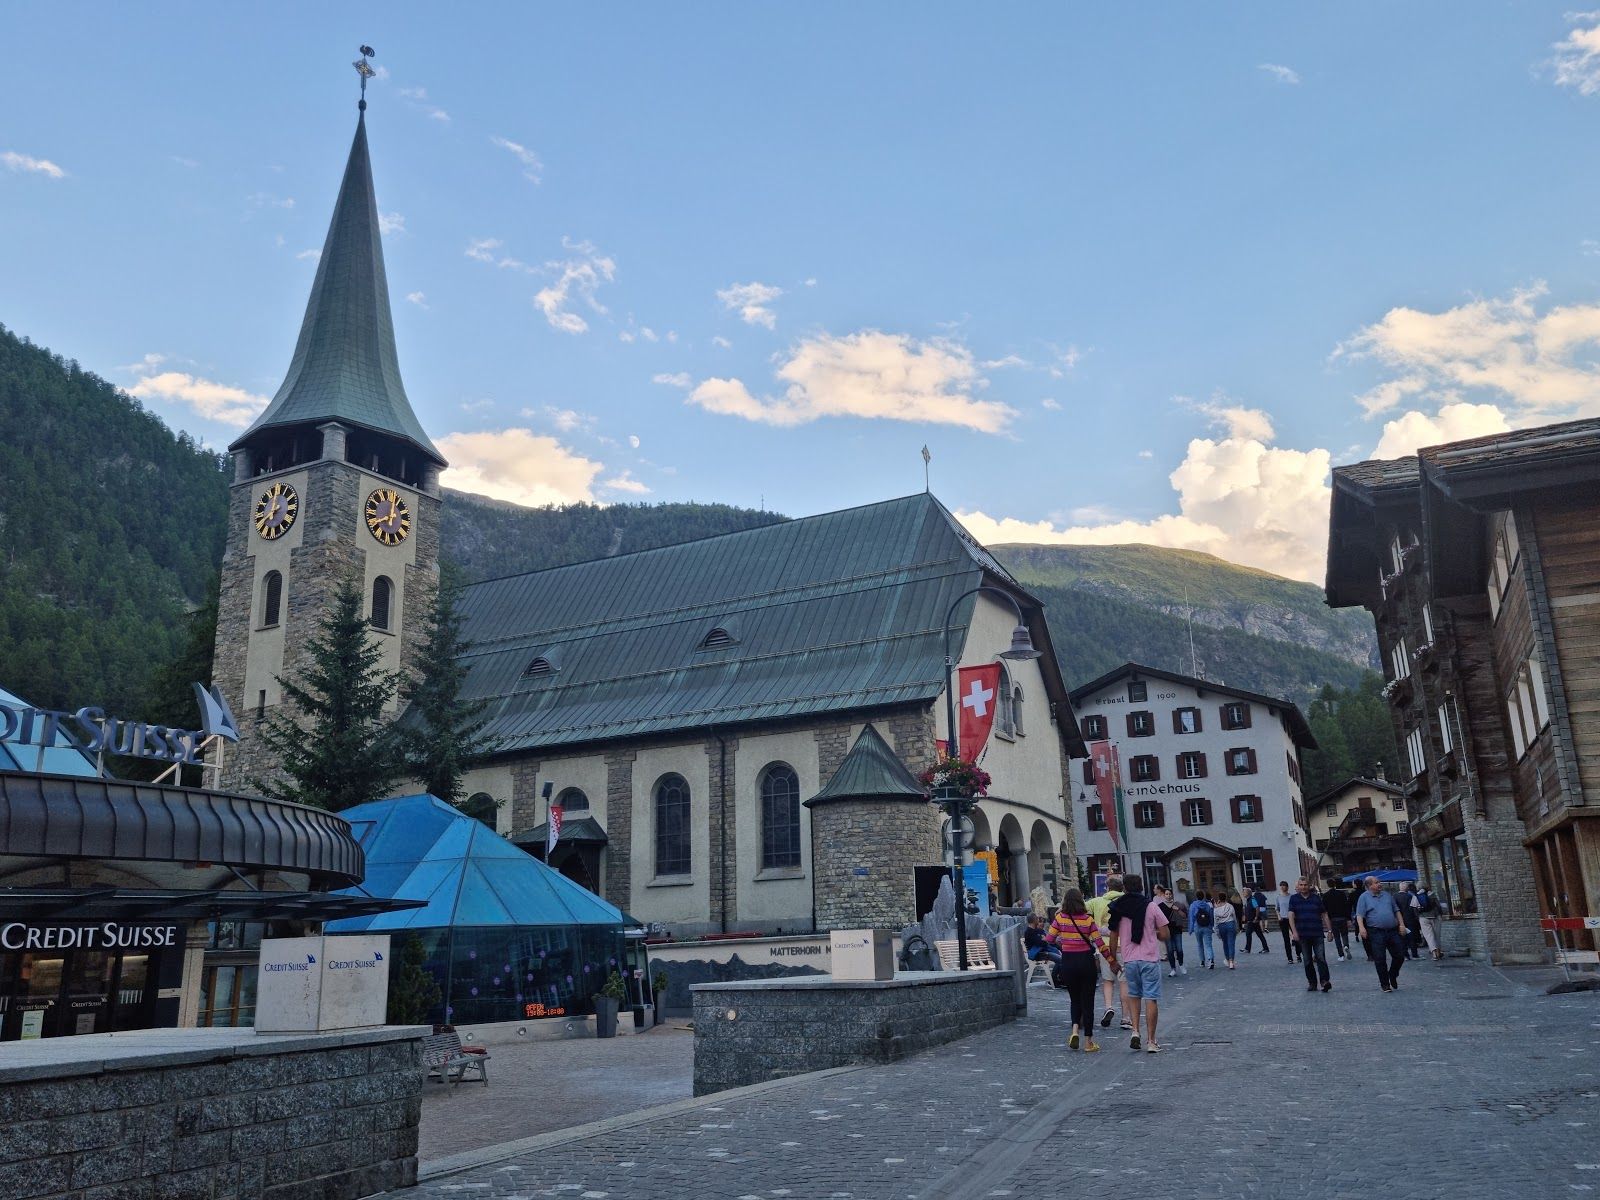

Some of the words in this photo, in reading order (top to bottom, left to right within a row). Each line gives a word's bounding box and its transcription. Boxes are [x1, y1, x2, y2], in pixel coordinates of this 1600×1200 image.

[1157, 692, 1176, 700] 1900
[75, 706, 204, 765] SUISSE
[1, 922, 99, 949] CREDIT
[101, 922, 177, 948] SUISSE
[770, 945, 821, 956] MATTERHORN
[264, 962, 288, 972] CREDIT
[288, 962, 309, 971] SUISSE
[328, 960, 354, 970] CREDIT
[354, 959, 376, 968] SUISSE
